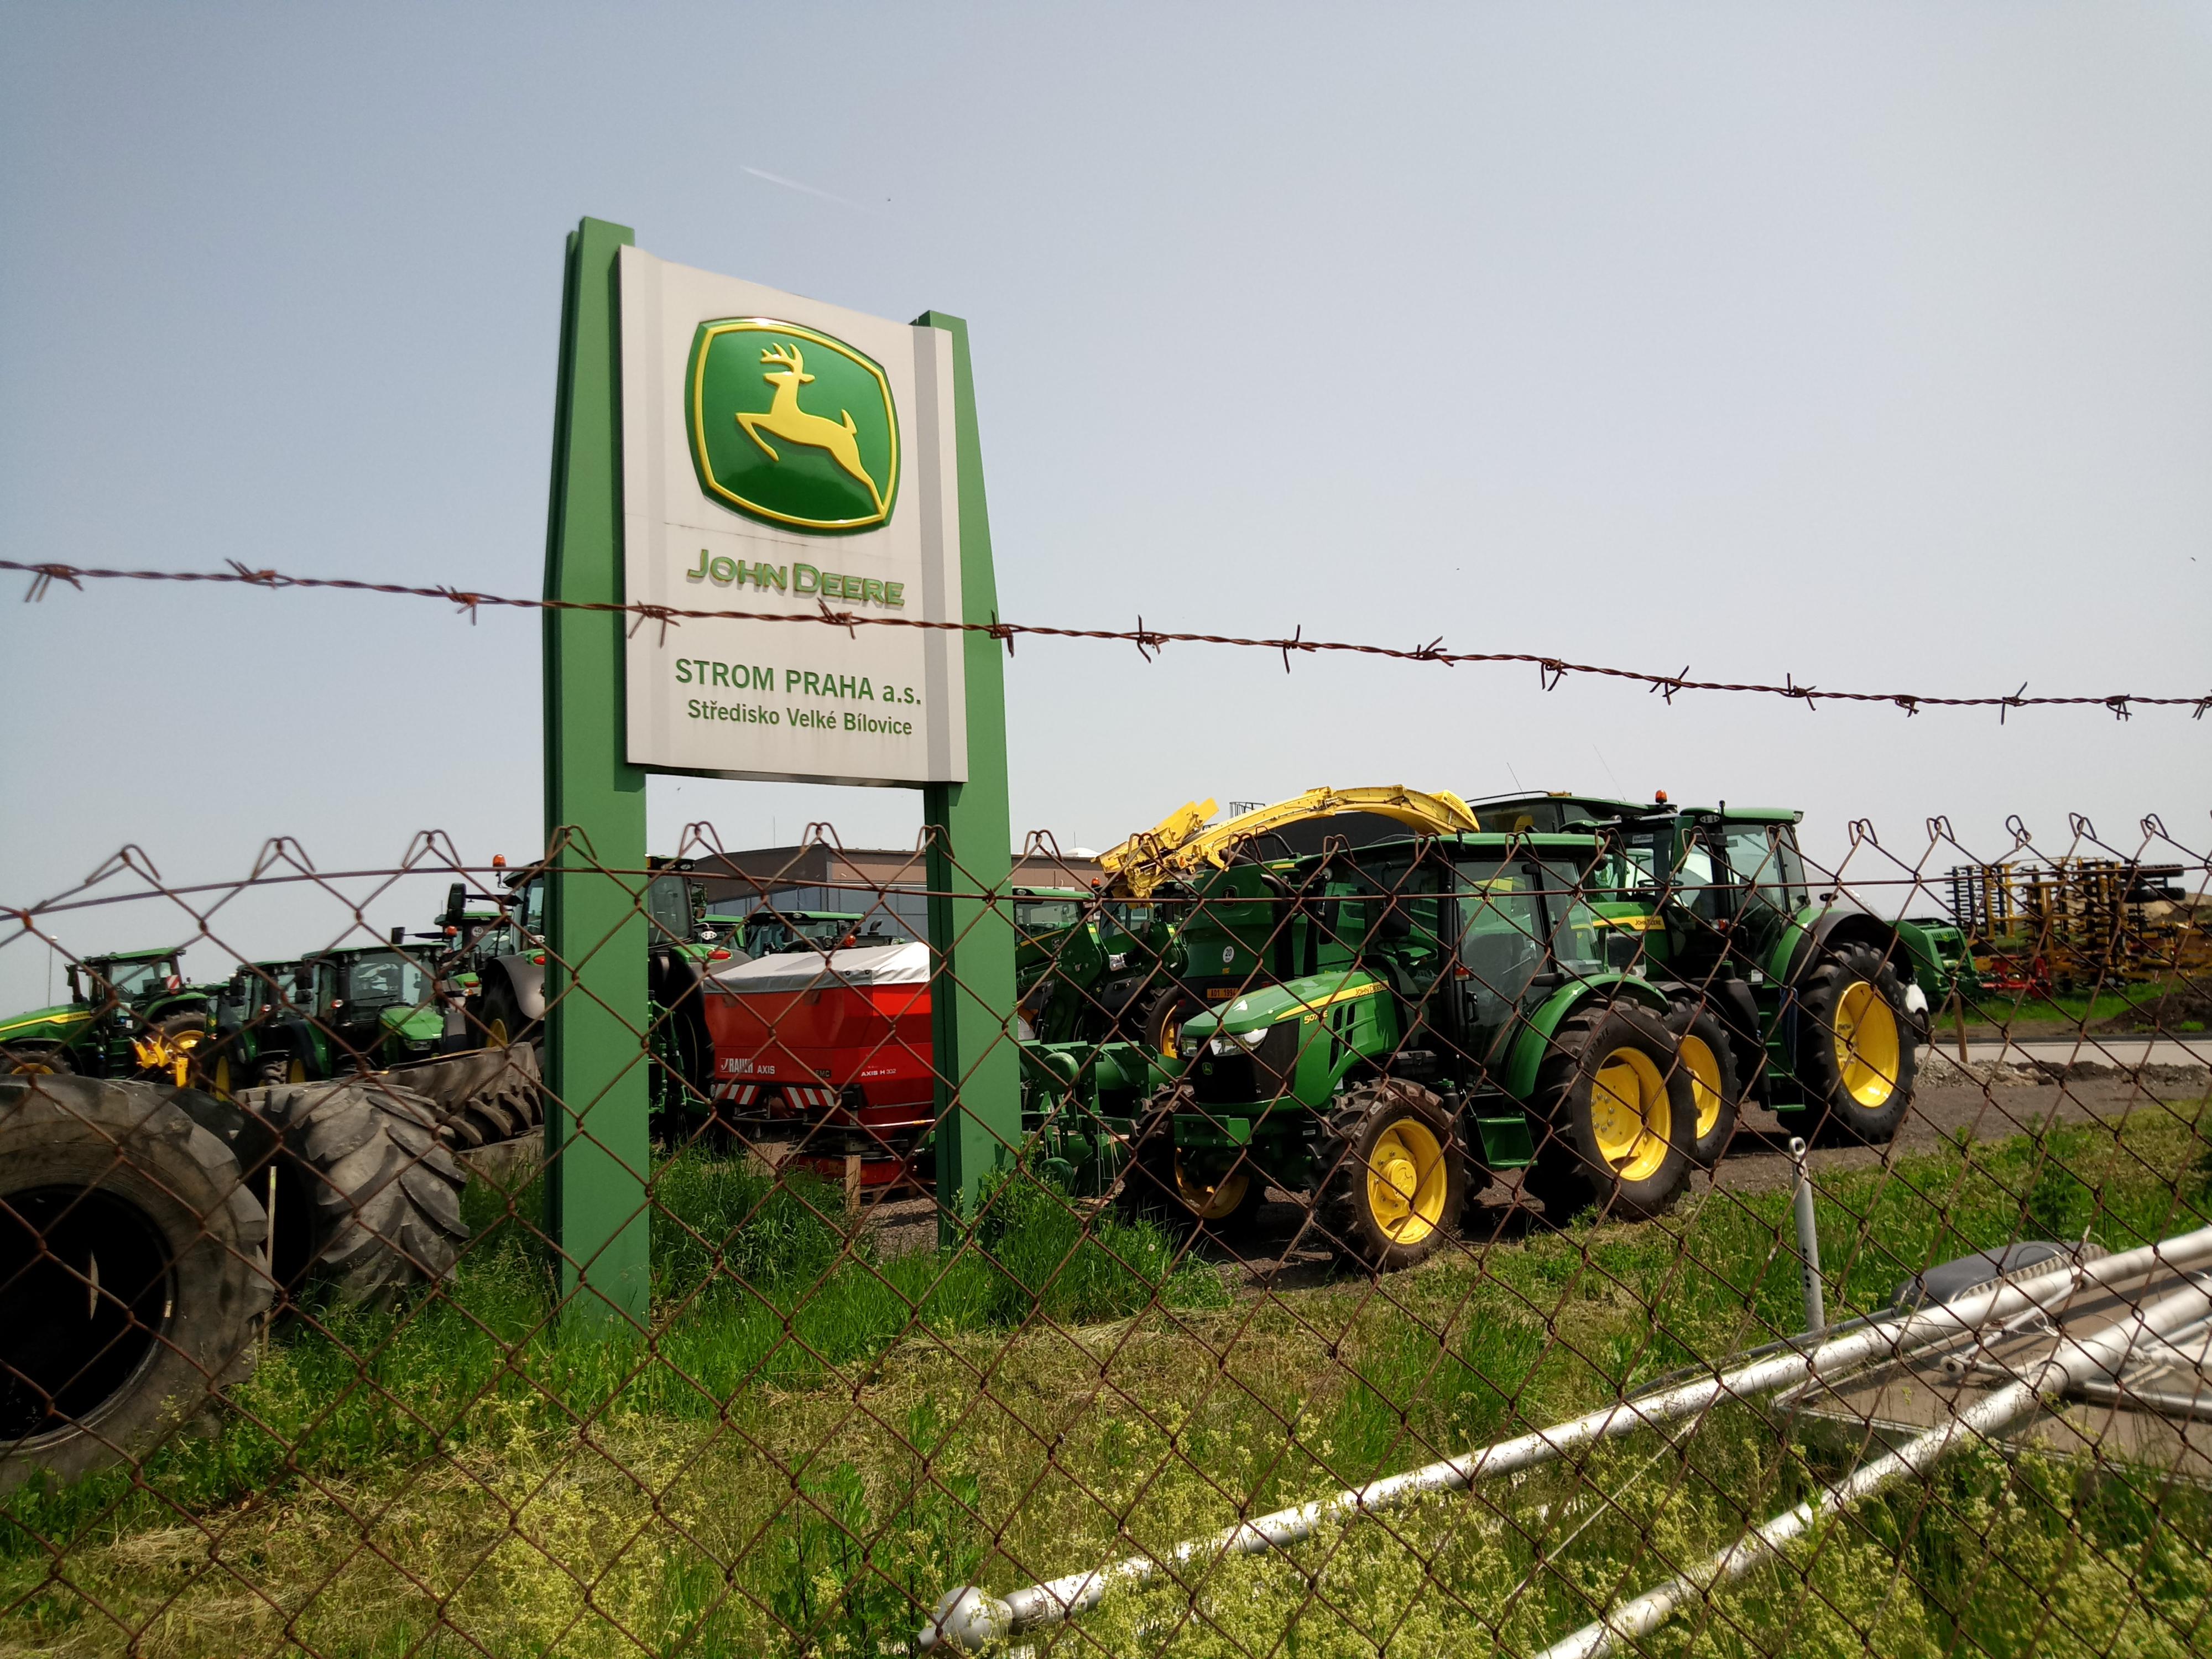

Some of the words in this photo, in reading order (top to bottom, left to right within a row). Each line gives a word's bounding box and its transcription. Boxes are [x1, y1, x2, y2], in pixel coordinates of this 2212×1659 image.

[687, 549, 787, 590] JOHN
[793, 563, 905, 607] DEERE
[675, 658, 775, 691] STROM
[786, 670, 874, 700] PRAHA
[883, 685, 921, 705] a.s.
[687, 700, 780, 725] Středisko
[786, 708, 837, 729] Velké
[843, 713, 912, 735] Bílovice
[1355, 988, 1369, 996] JOHN
[1304, 1010, 1328, 1024] 507E
[757, 1065, 775, 1074] AXIS
